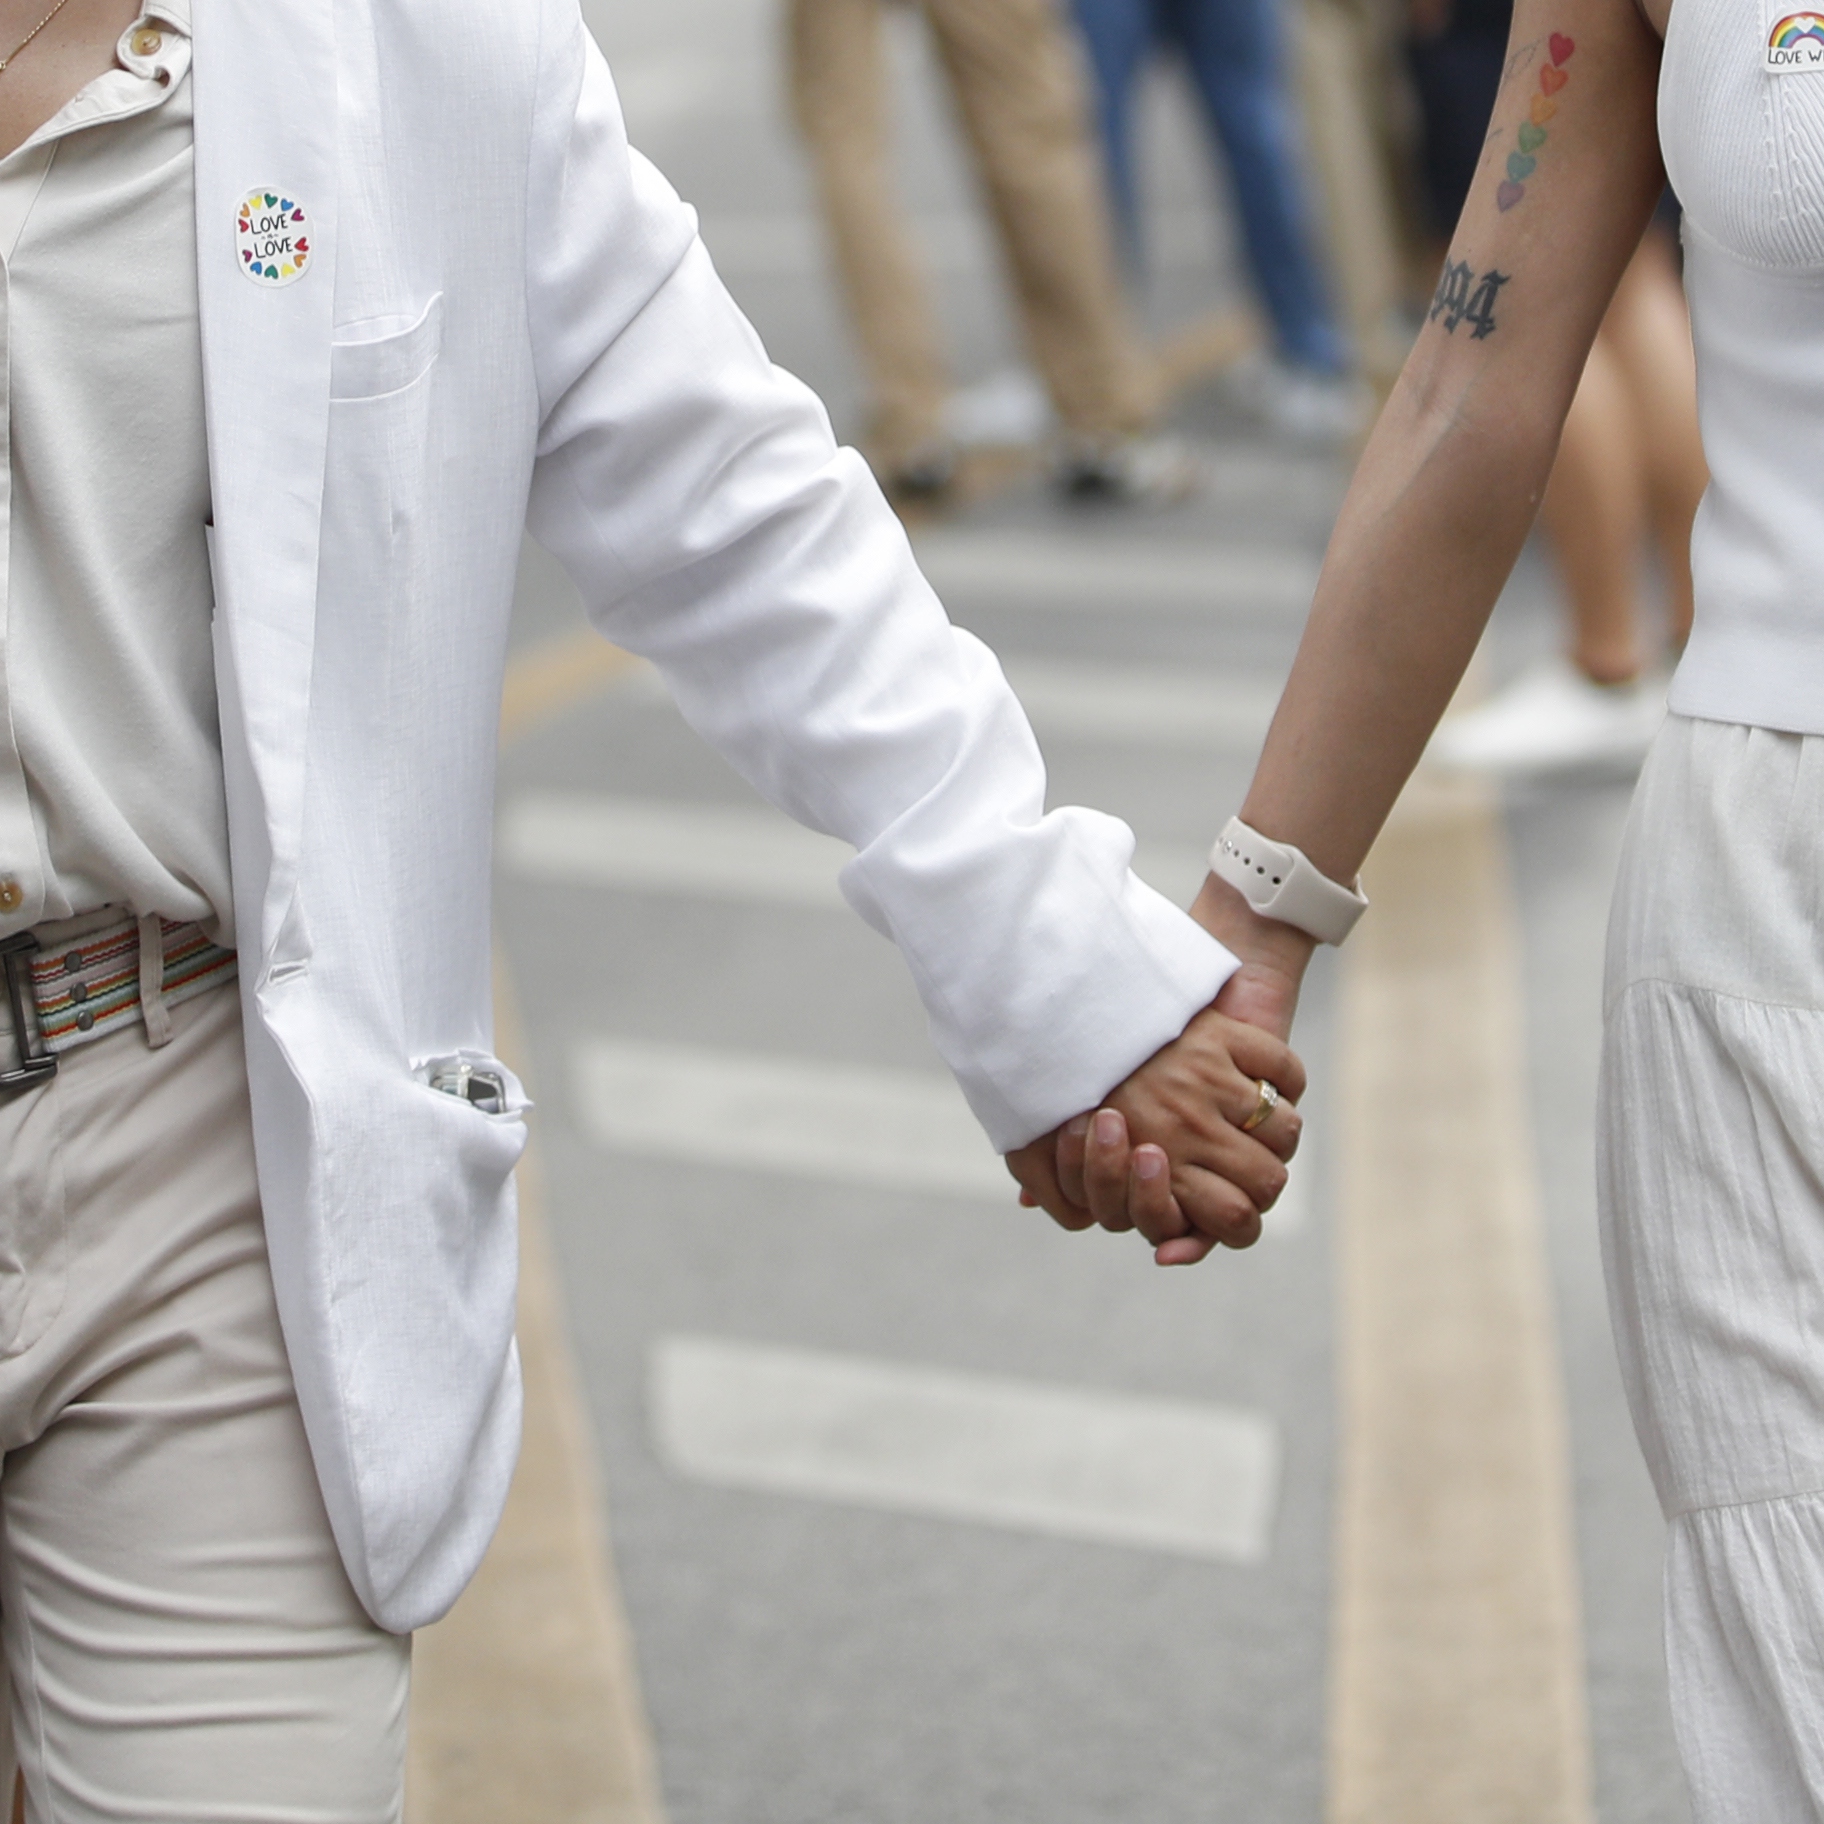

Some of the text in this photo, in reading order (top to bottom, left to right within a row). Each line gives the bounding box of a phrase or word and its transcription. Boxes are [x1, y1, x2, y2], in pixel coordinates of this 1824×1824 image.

[1768, 47, 1802, 65] LOVE
[250, 213, 288, 235] LOVE
[254, 236, 293, 259] LOVE
